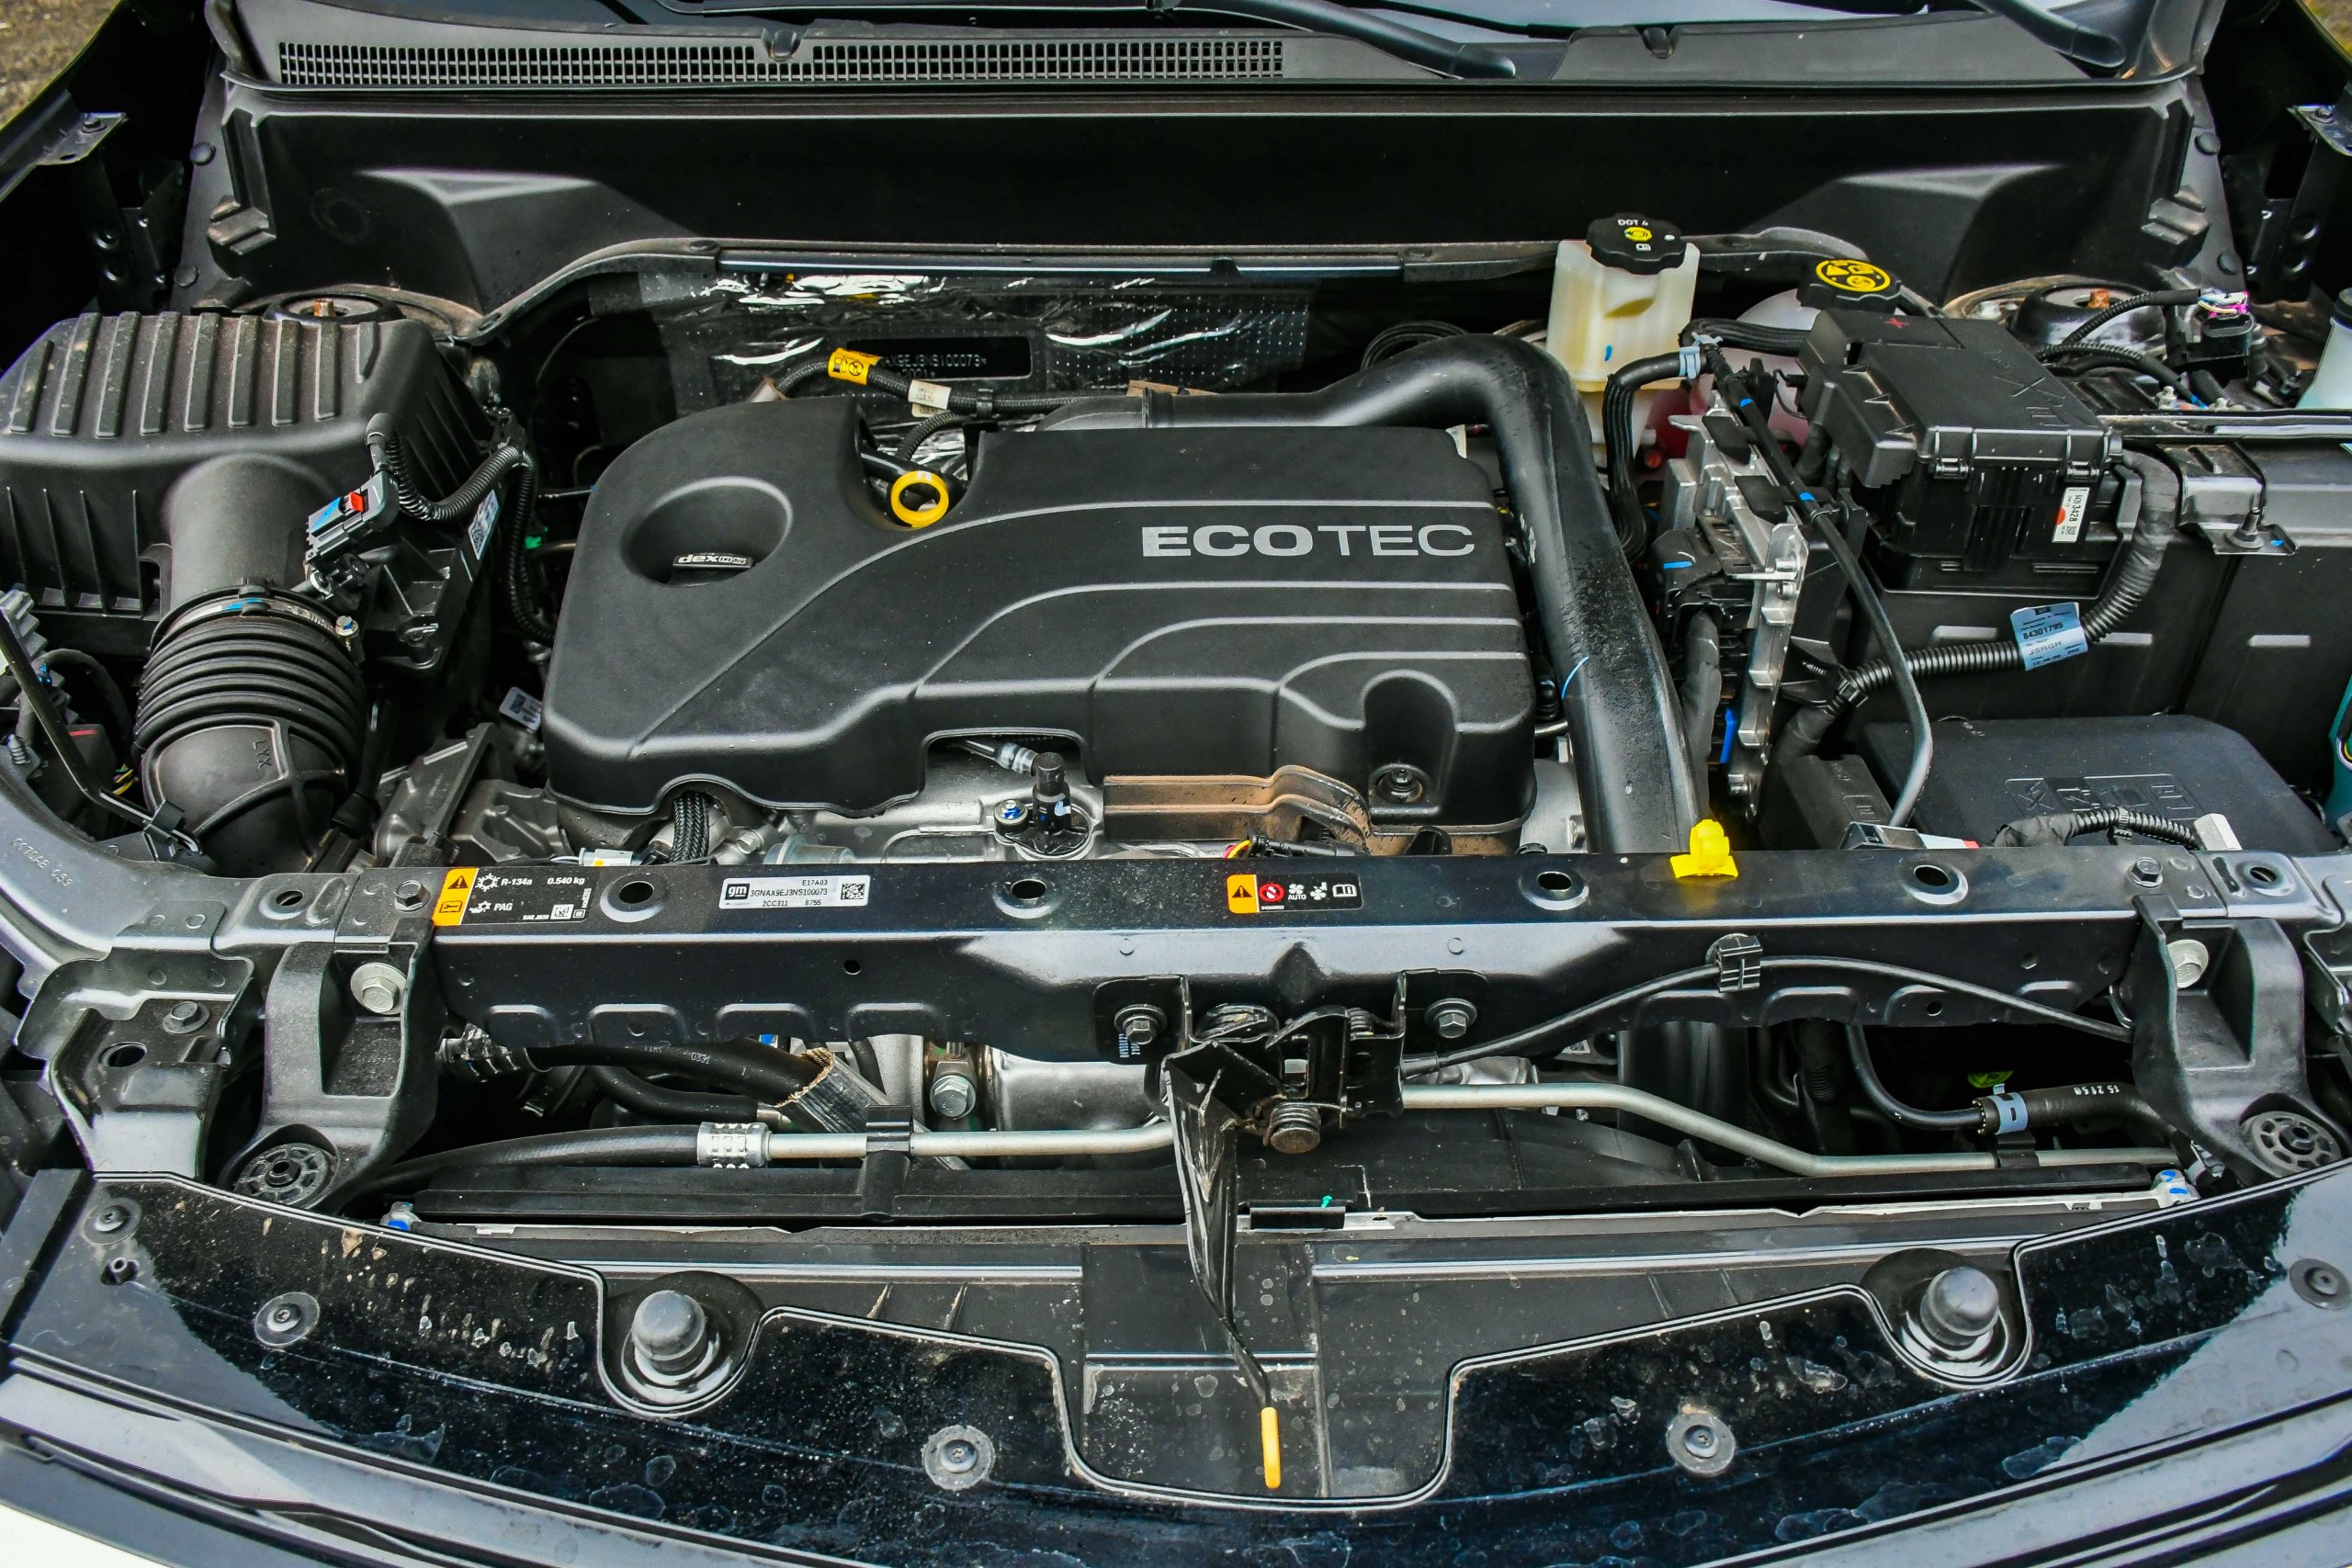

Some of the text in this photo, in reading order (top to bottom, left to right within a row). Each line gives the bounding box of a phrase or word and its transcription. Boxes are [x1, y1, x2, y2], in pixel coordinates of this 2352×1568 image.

[1142, 525, 1475, 557] ECOTEC
[678, 554, 747, 565] dexos
[2022, 621, 2064, 639] 84301795
[500, 876, 586, 886] R-134a 0.540 kg
[729, 886, 748, 897] gm
[750, 888, 828, 897] 3GNAX9EJ3NS100073
[493, 902, 514, 911] PAG
